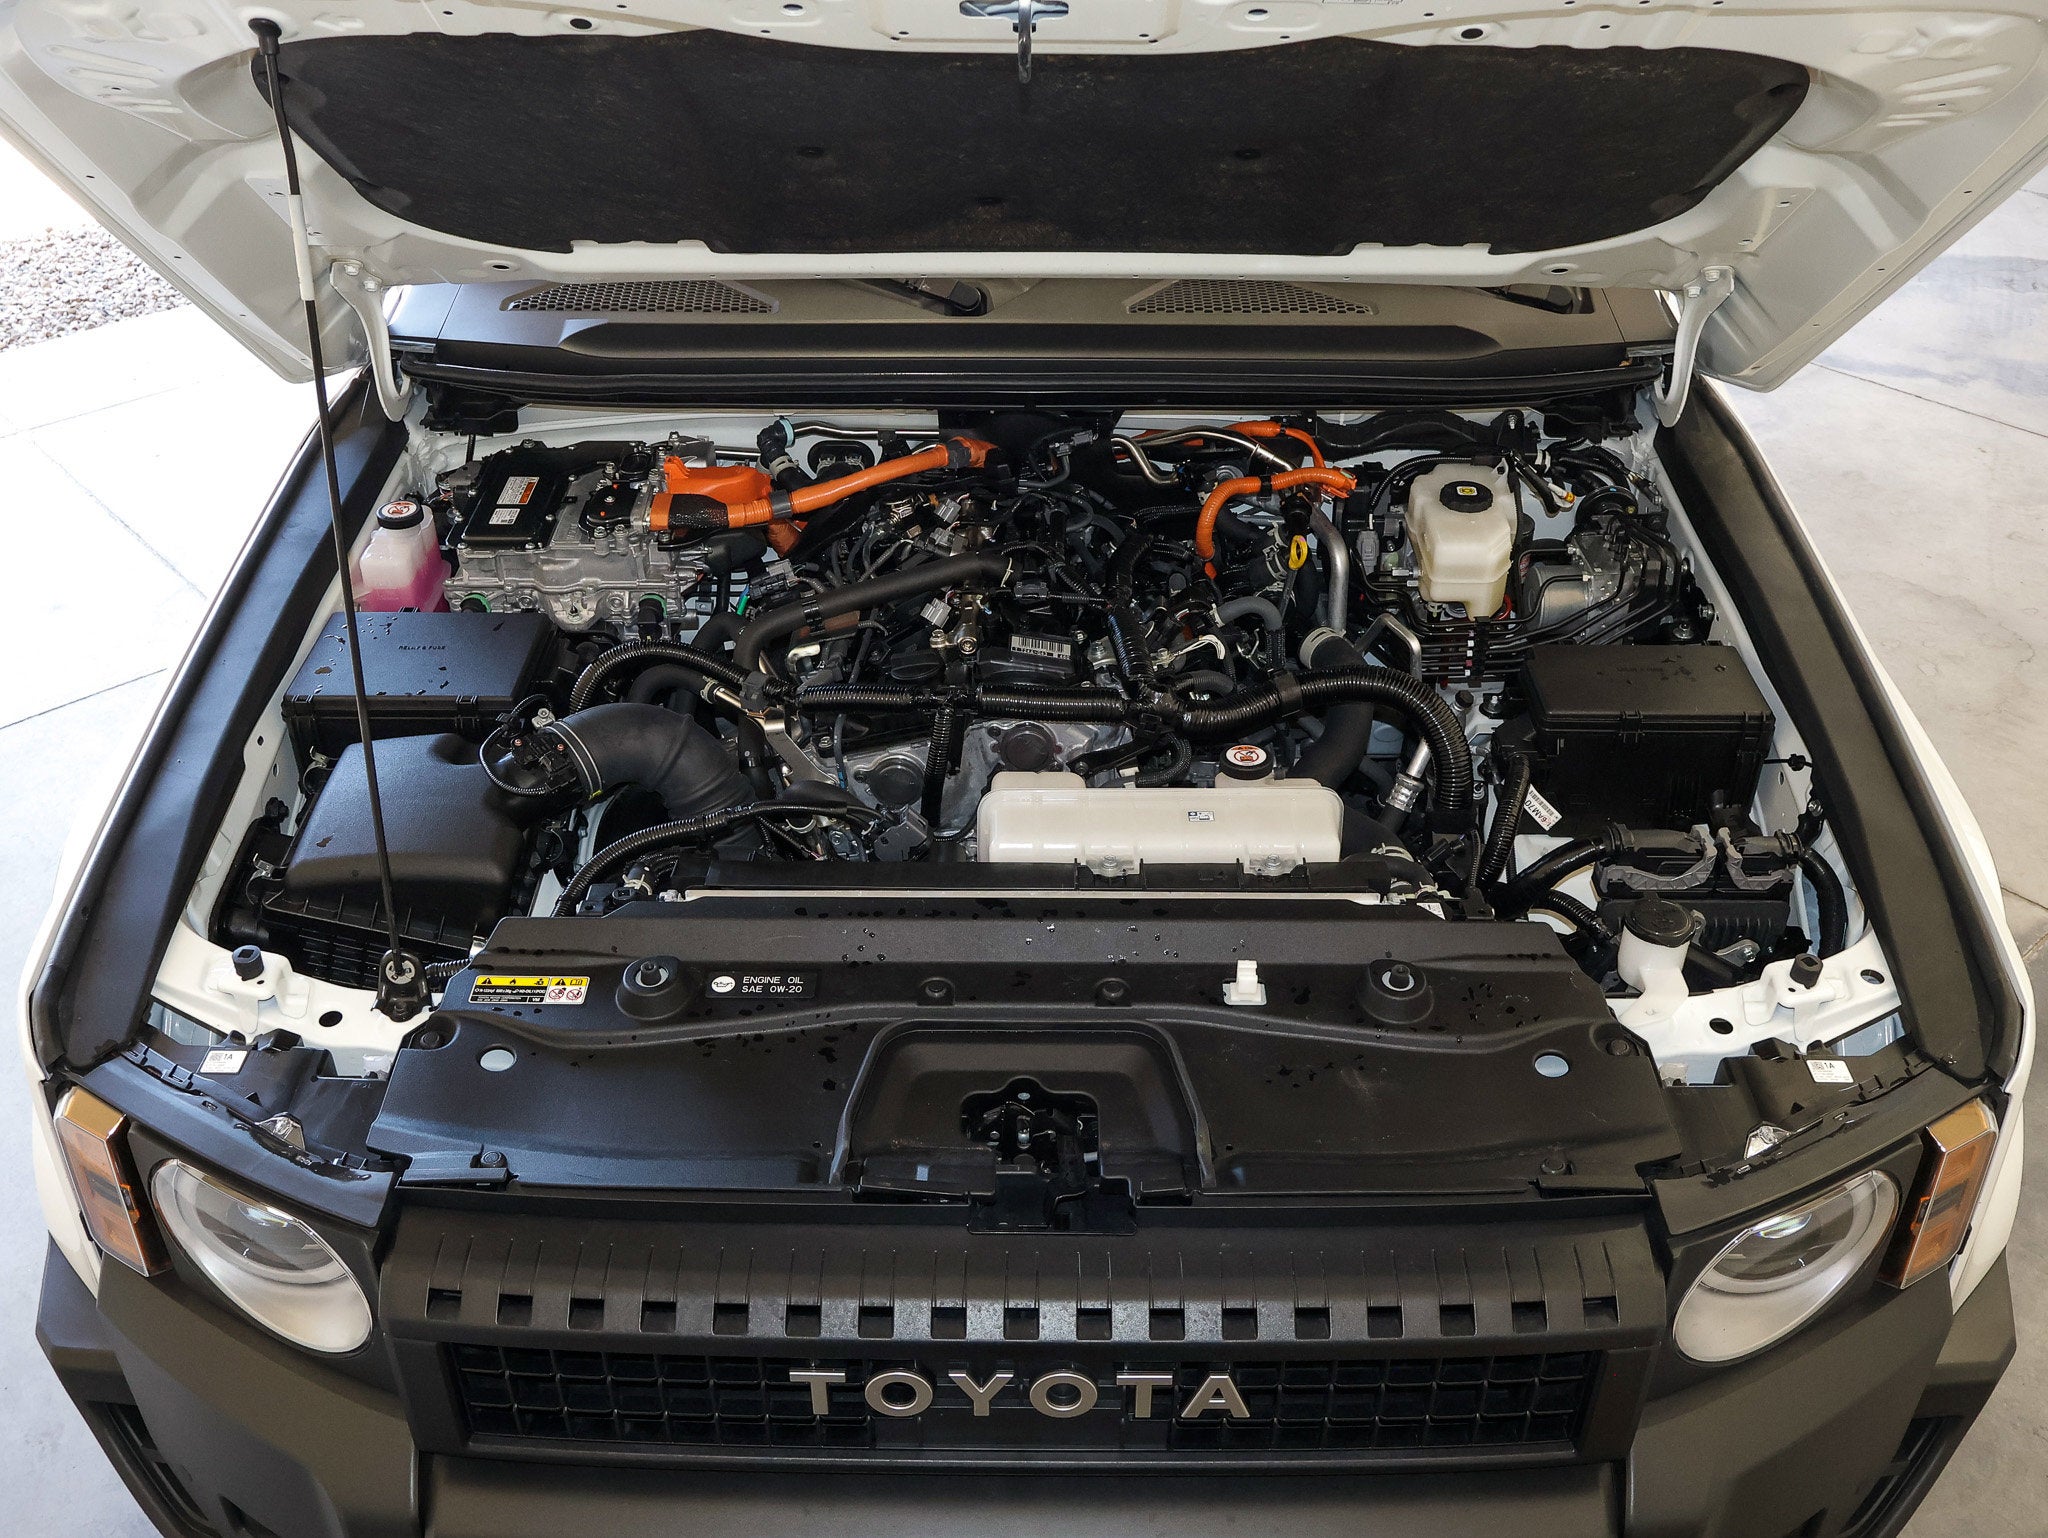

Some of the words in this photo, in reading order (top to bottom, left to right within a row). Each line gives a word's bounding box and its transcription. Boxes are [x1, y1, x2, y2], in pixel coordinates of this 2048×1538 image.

[743, 976, 781, 984] ENGINE
[787, 976, 804, 984] OIL
[741, 985, 763, 993] SAE
[769, 985, 803, 993] 0W-20
[789, 1367, 1251, 1418] TOYOTA
